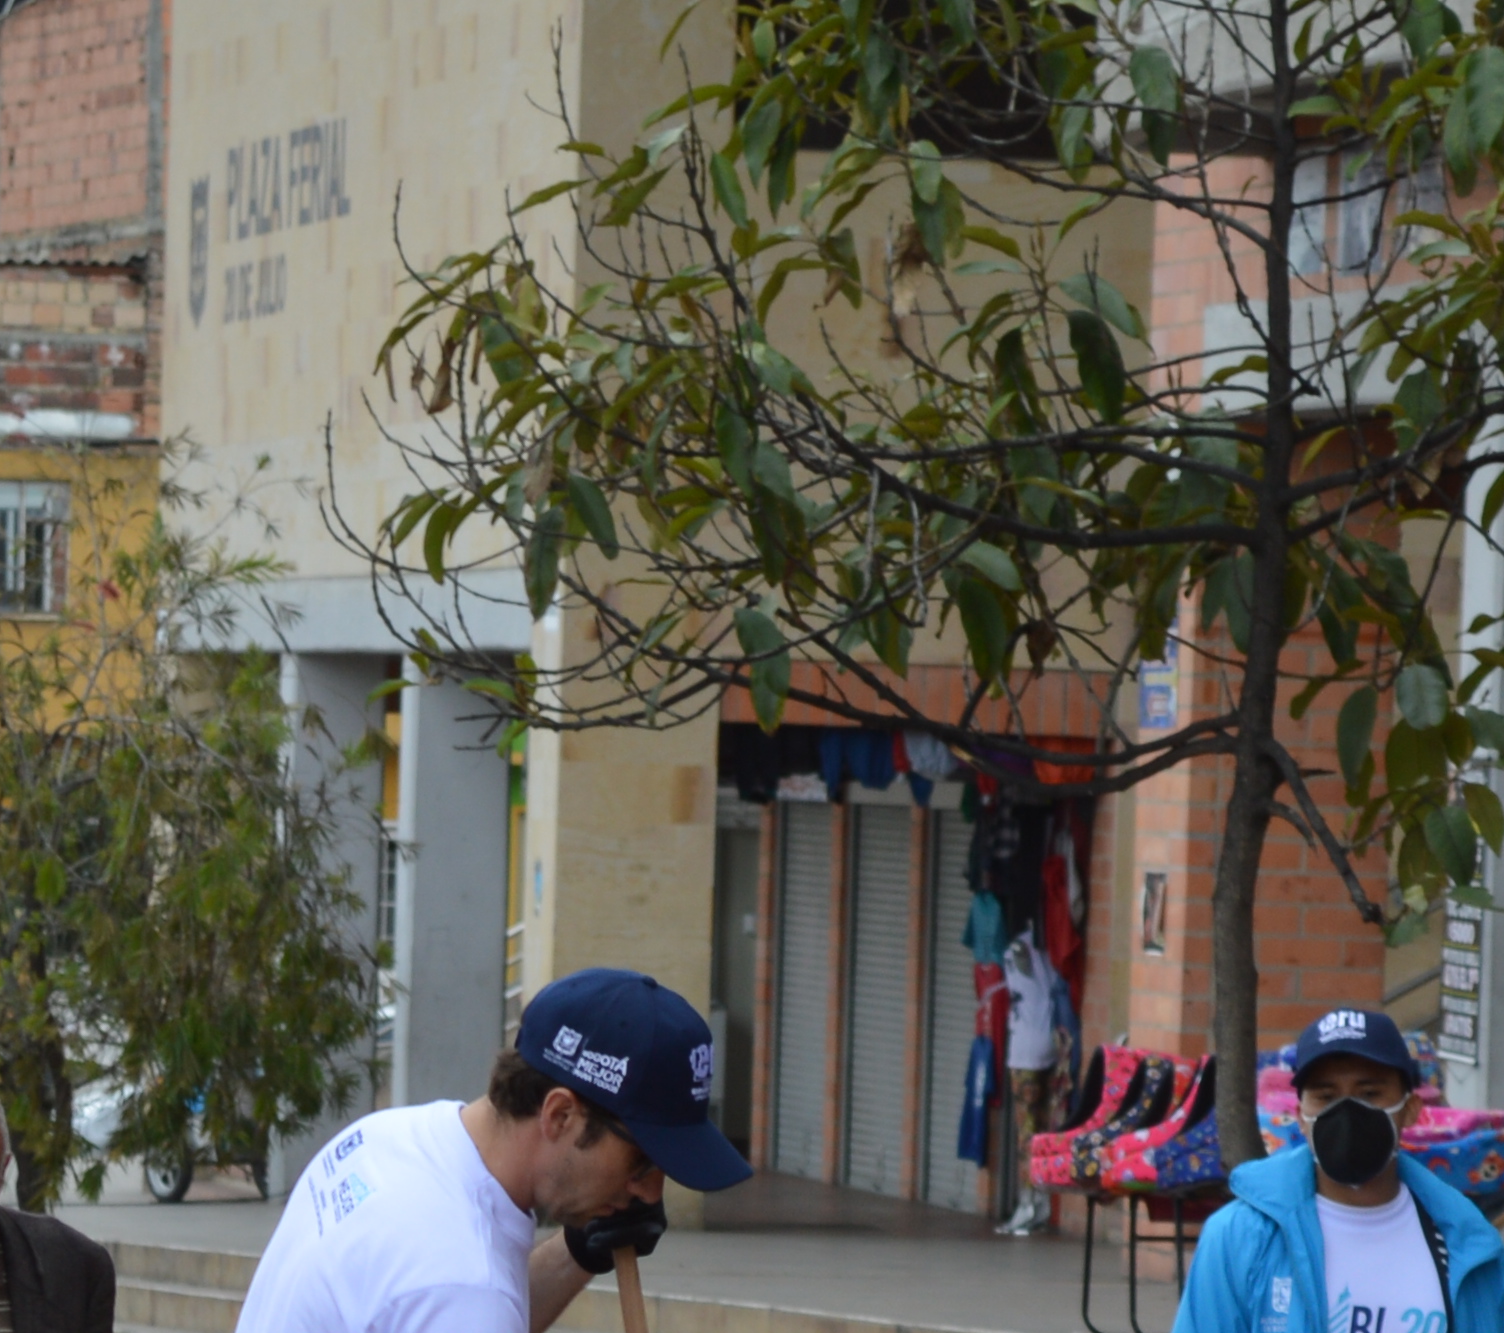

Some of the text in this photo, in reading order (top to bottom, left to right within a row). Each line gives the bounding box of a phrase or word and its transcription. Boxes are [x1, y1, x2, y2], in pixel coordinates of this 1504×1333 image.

[227, 118, 351, 243] PLAZA FERIAL
[576, 1057, 623, 1088] MEJOR
